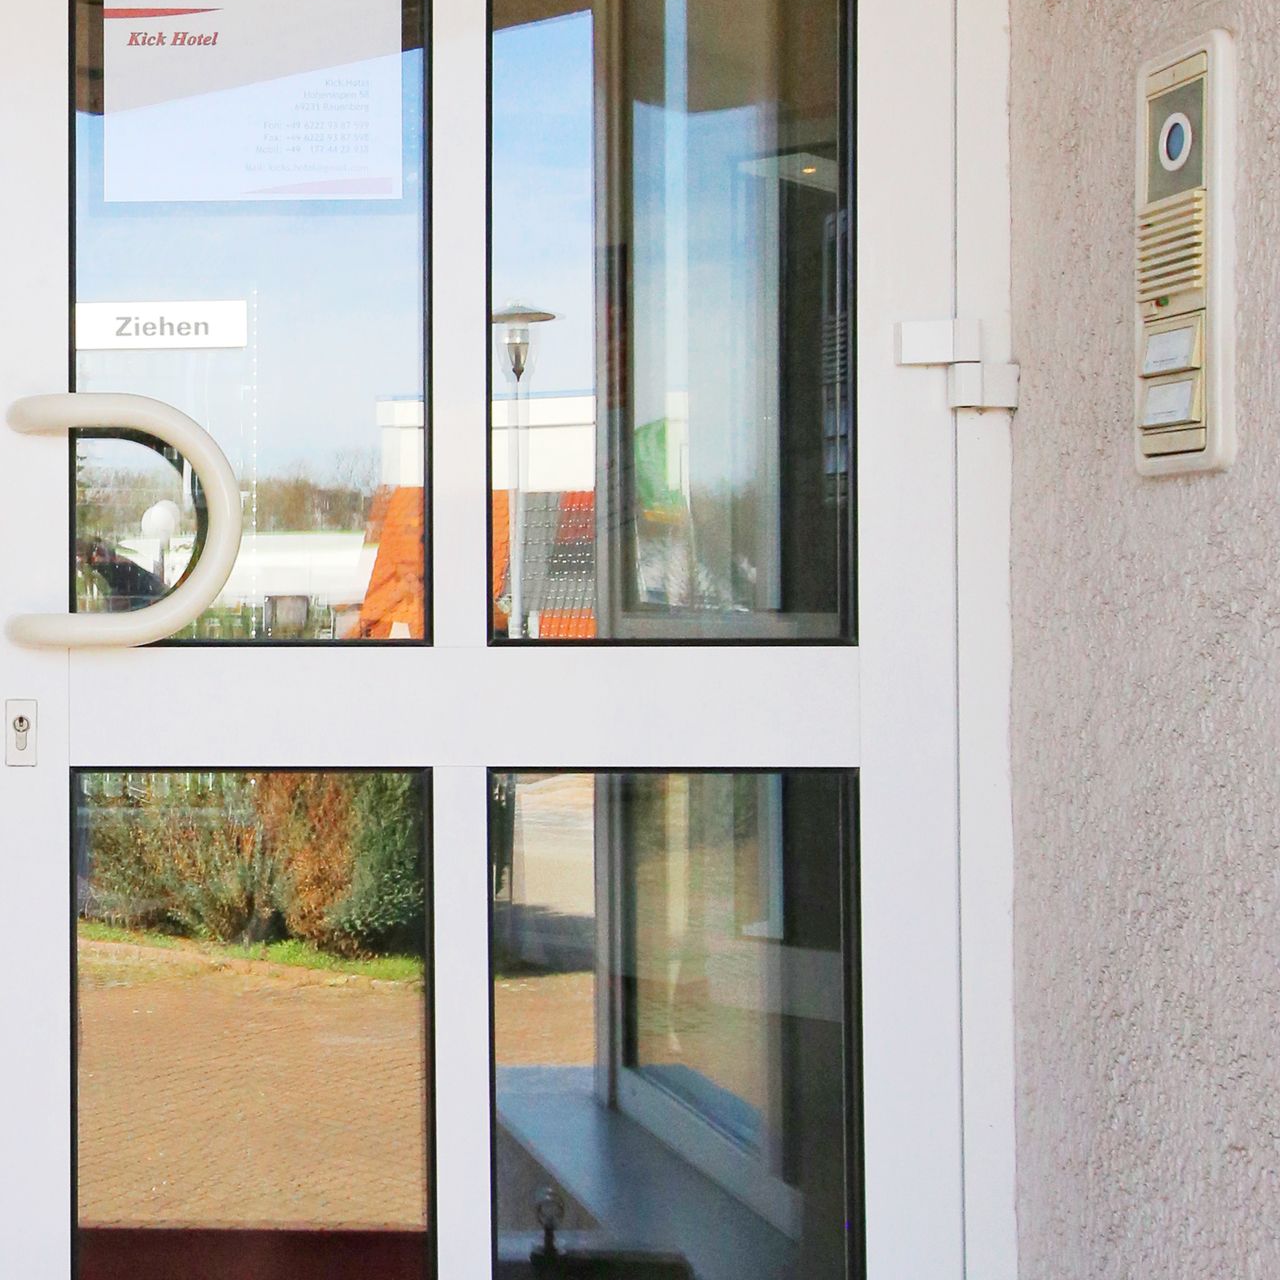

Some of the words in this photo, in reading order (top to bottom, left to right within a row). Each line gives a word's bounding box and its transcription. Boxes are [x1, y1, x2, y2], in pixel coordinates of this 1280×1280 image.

[127, 31, 167, 47] Kick
[170, 31, 218, 46] Hotel
[115, 316, 209, 336] Ziehen
